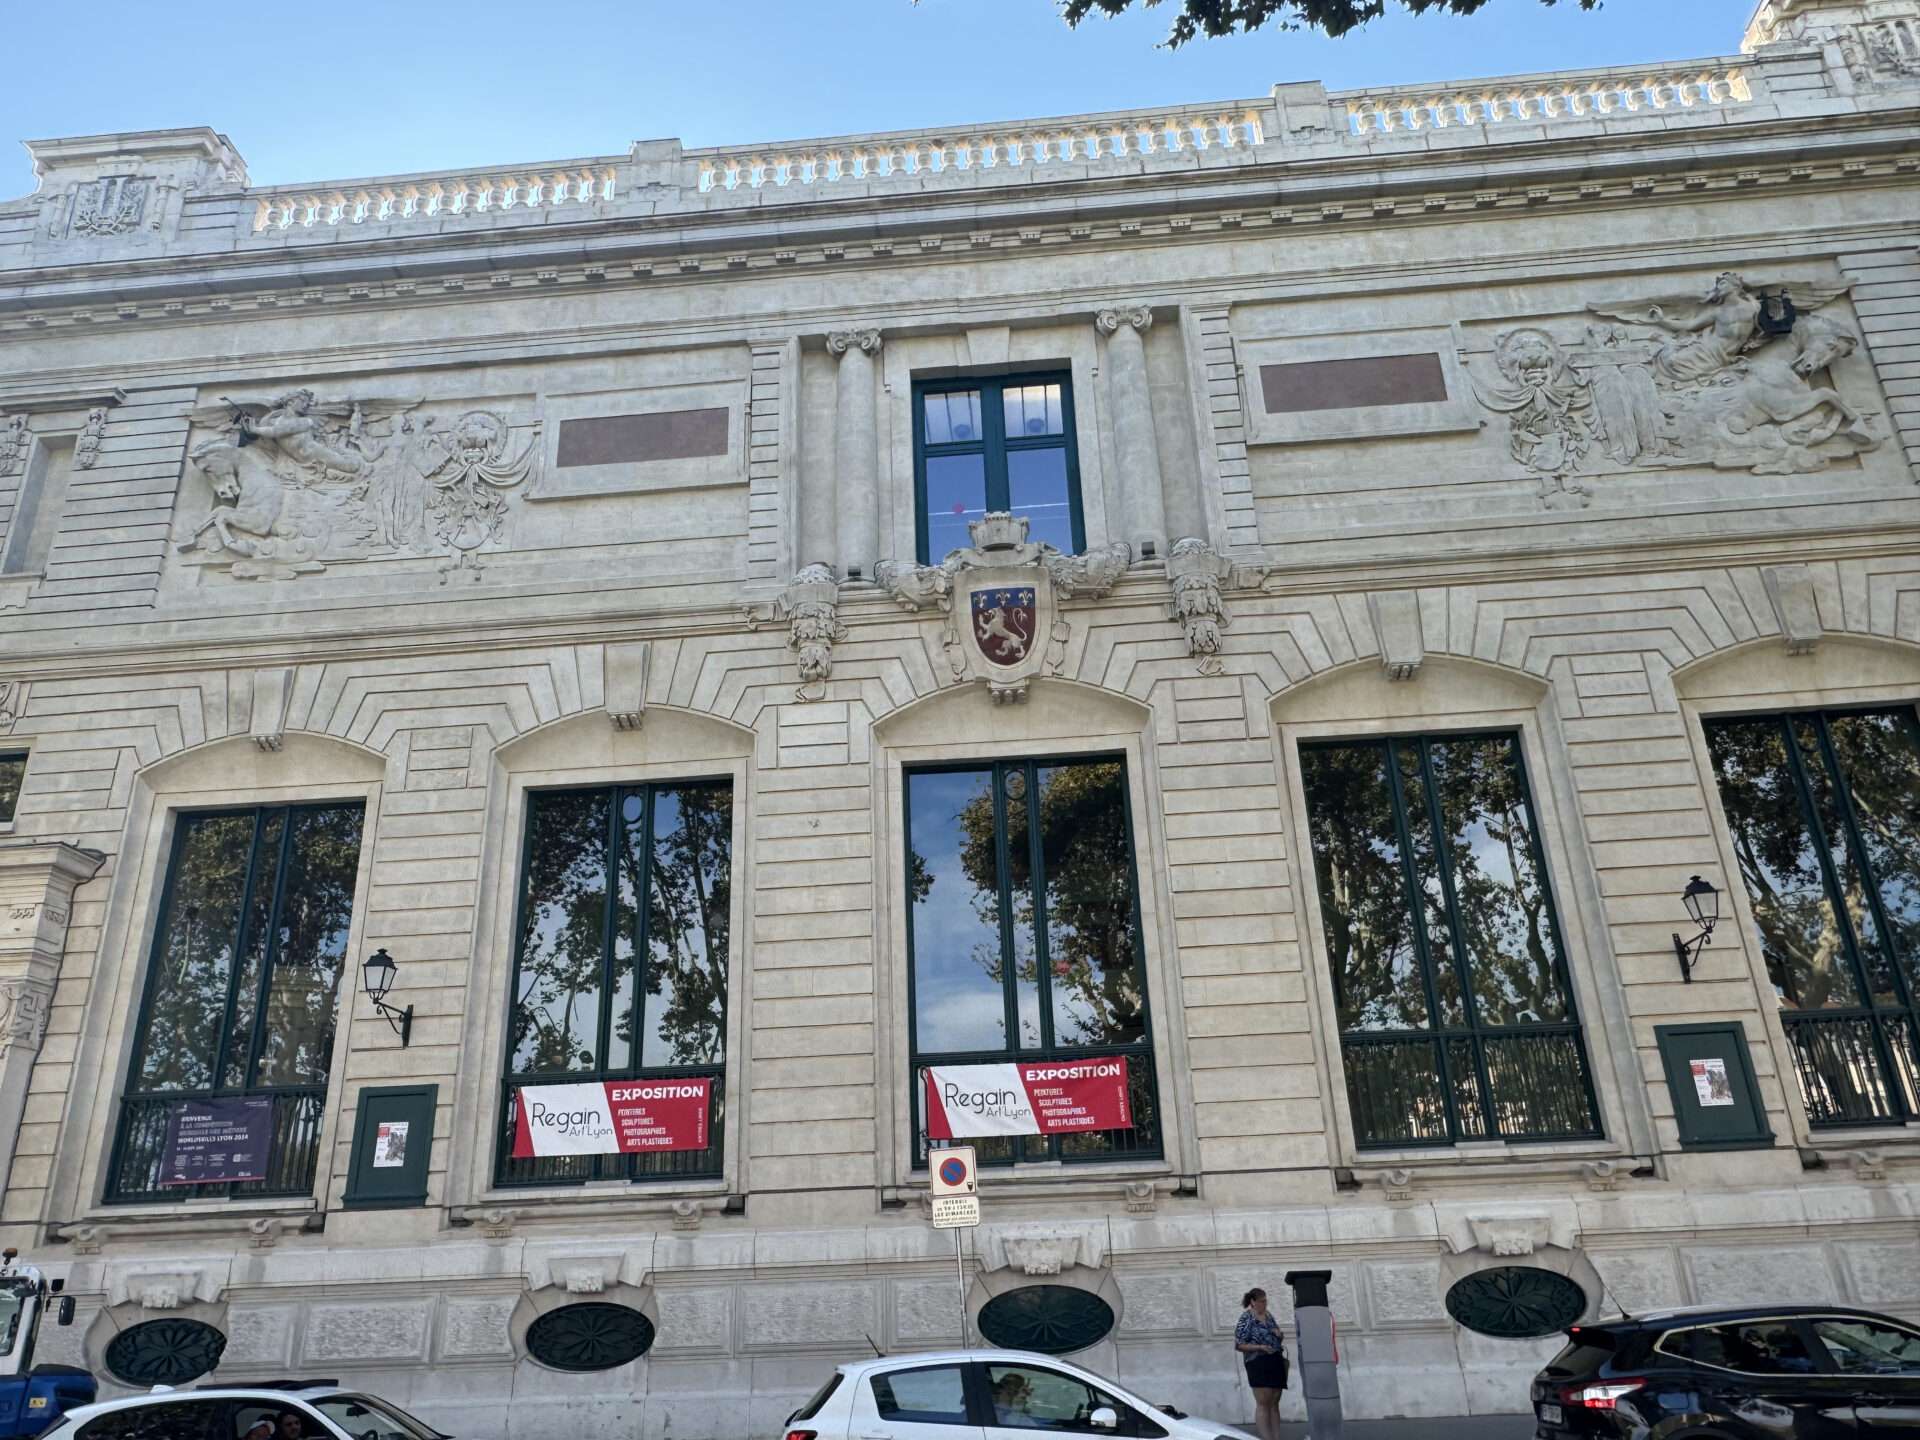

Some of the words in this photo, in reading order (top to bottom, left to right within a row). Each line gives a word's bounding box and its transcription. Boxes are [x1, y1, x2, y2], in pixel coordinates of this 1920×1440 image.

[1026, 1064, 1120, 1081] EXPOSITION
[612, 1086, 704, 1101] EXPOSITION
[945, 1083, 1017, 1114] Regain
[532, 1102, 600, 1133] Regain
